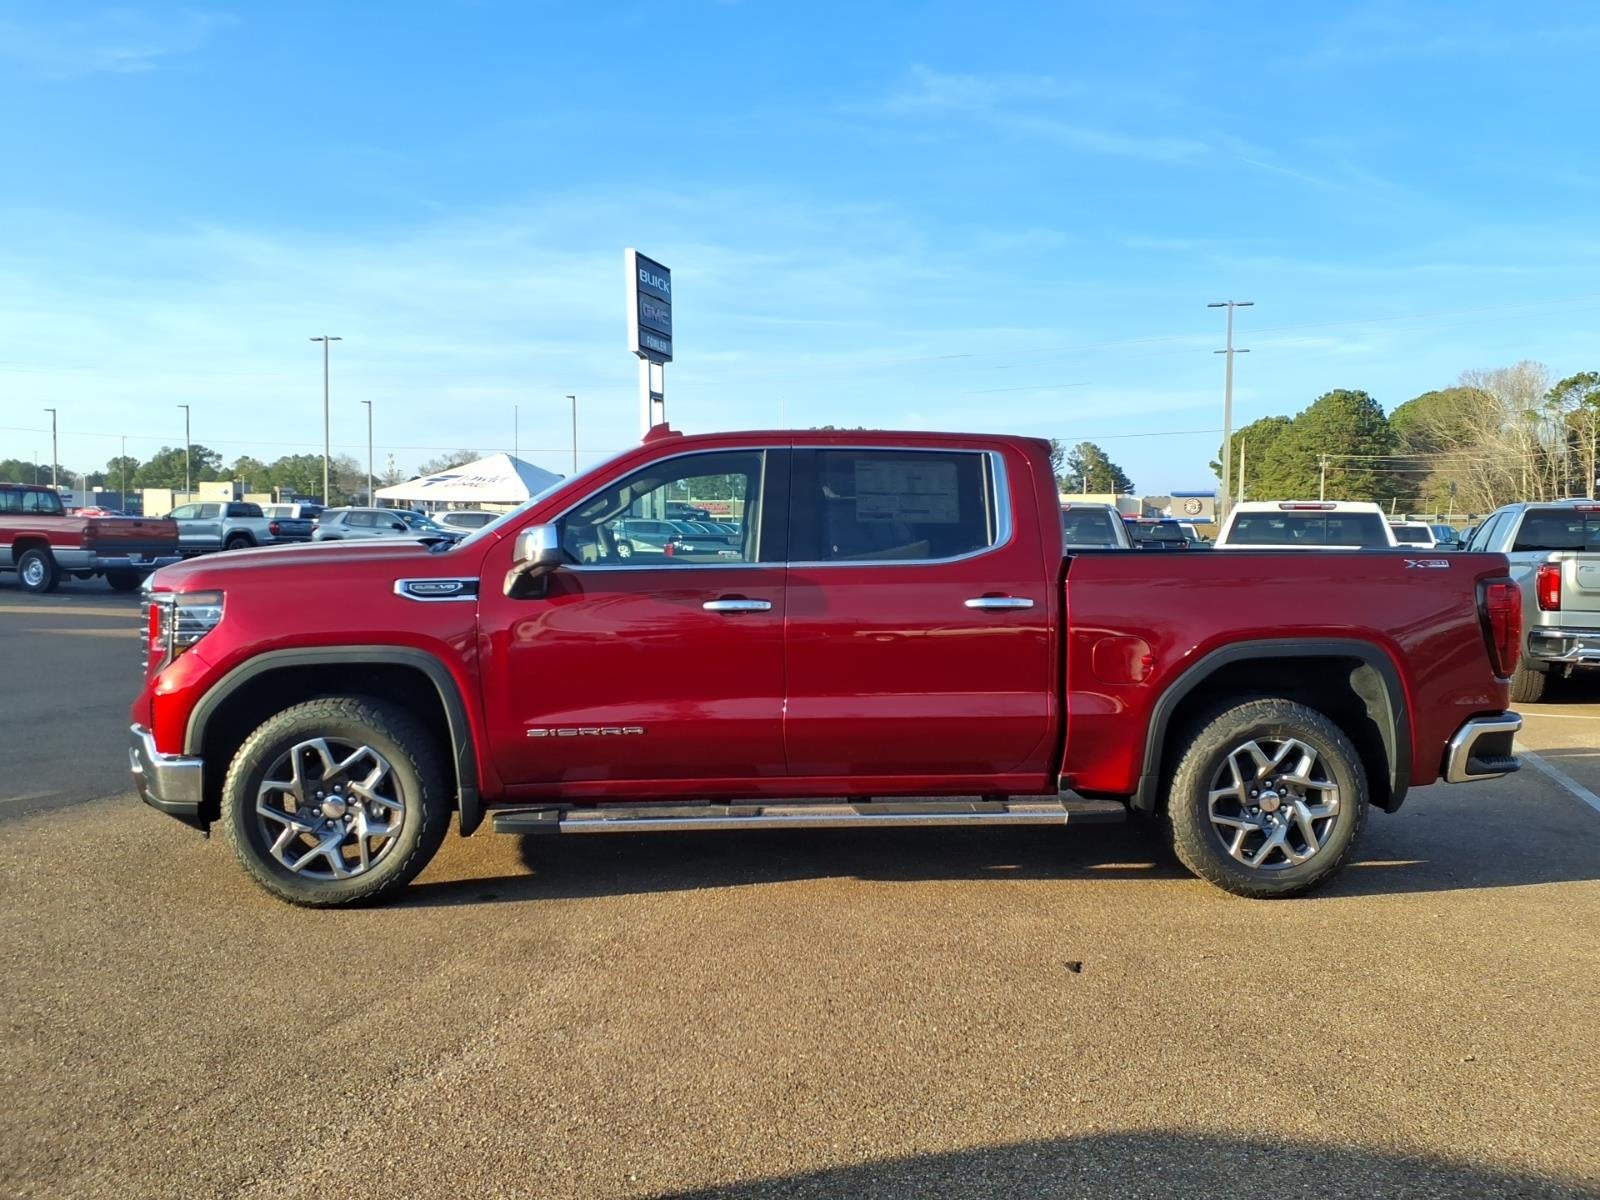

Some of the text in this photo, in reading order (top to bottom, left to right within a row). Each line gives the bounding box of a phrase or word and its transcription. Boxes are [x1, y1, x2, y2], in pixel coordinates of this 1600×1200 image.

[639, 268, 670, 294] BUICK
[642, 303, 670, 325] GMC
[527, 726, 644, 737] SIERRA
